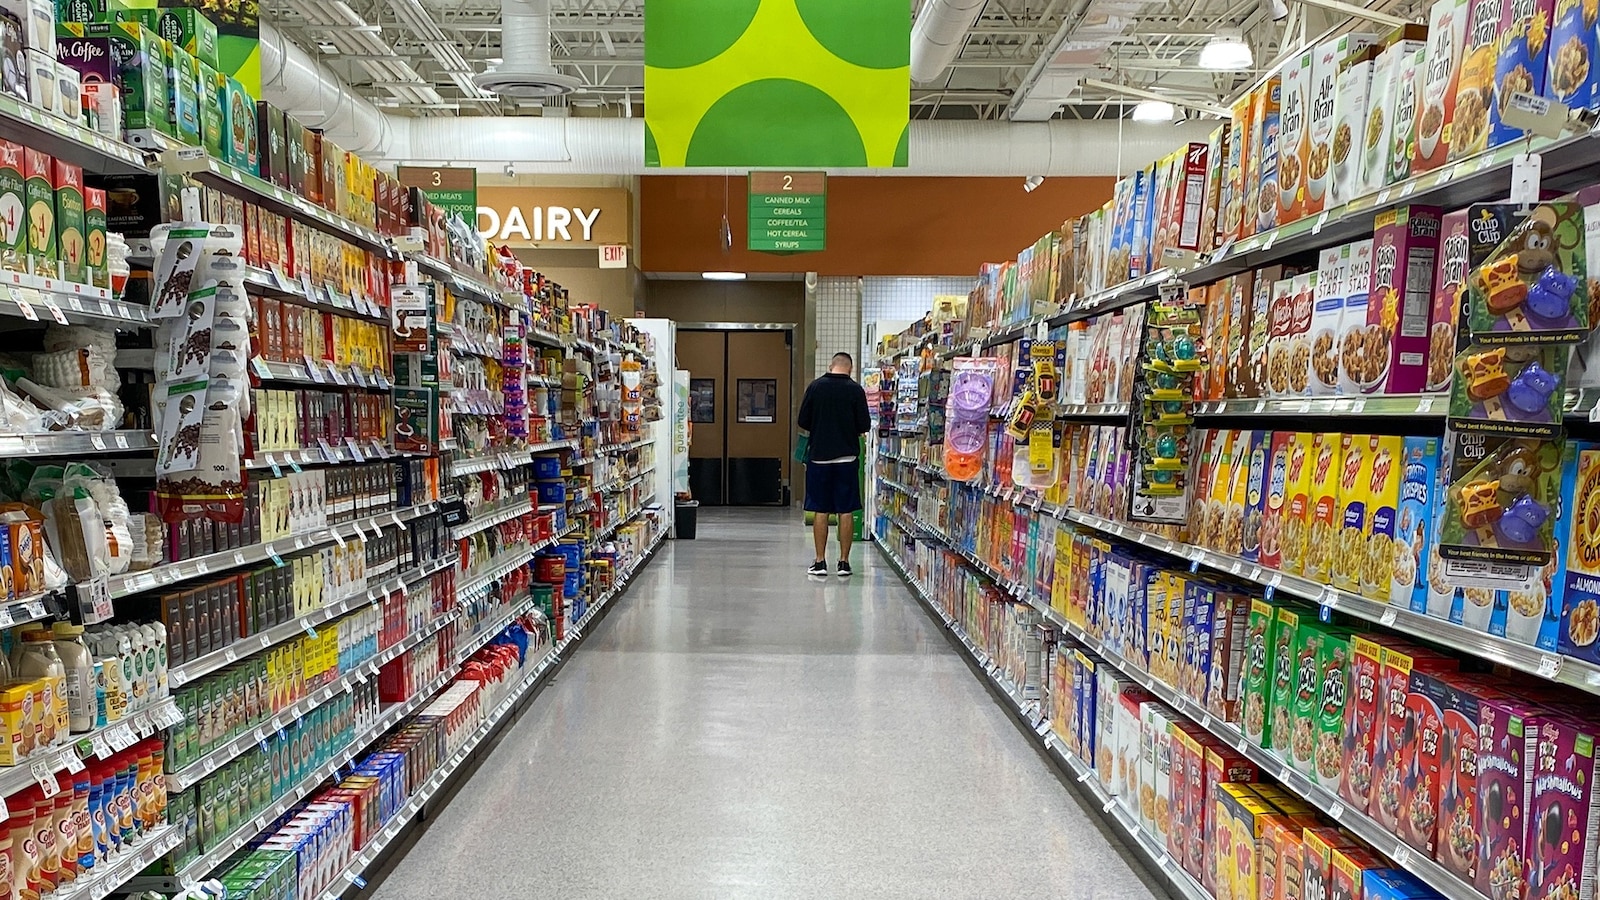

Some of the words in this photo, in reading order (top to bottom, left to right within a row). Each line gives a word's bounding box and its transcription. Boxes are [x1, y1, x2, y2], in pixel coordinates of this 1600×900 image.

[57, 42, 70, 60] Mr.
[71, 41, 104, 62] Coffee
[1427, 58, 1449, 87] Bran
[1314, 99, 1333, 123] Bran
[1397, 105, 1414, 130] Bran
[1283, 113, 1299, 135] Bran
[432, 171, 442, 187] 3
[783, 175, 793, 190] 2
[8, 205, 14, 231] 4
[39, 213, 45, 239] 4
[475, 207, 601, 241] DAIRY
[1410, 218, 1439, 230] Raisin
[1472, 217, 1498, 233] Chip
[1412, 226, 1436, 237] Bran
[1478, 231, 1500, 245] Clip
[70, 239, 77, 262] 4
[94, 236, 101, 257] 2
[604, 247, 621, 261] EXIT
[1320, 266, 1345, 284] SMART
[1350, 261, 1370, 278] SMAR
[1318, 281, 1343, 299] START
[1348, 276, 1368, 293] STAR
[677, 401, 687, 453] guarantee
[1460, 433, 1486, 446] Chip
[1464, 445, 1486, 459] Clip
[1402, 482, 1427, 504] KRISPIES
[1579, 475, 1596, 523] HONEY
[1472, 550, 1489, 558] friends
[1357, 641, 1368, 652] LARGE
[1368, 646, 1377, 657] SIZE
[1387, 653, 1400, 665] LARGE
[1400, 658, 1410, 670] SIZE
[1477, 755, 1519, 778] Marshmallows
[1535, 774, 1583, 800] Marshmallows
